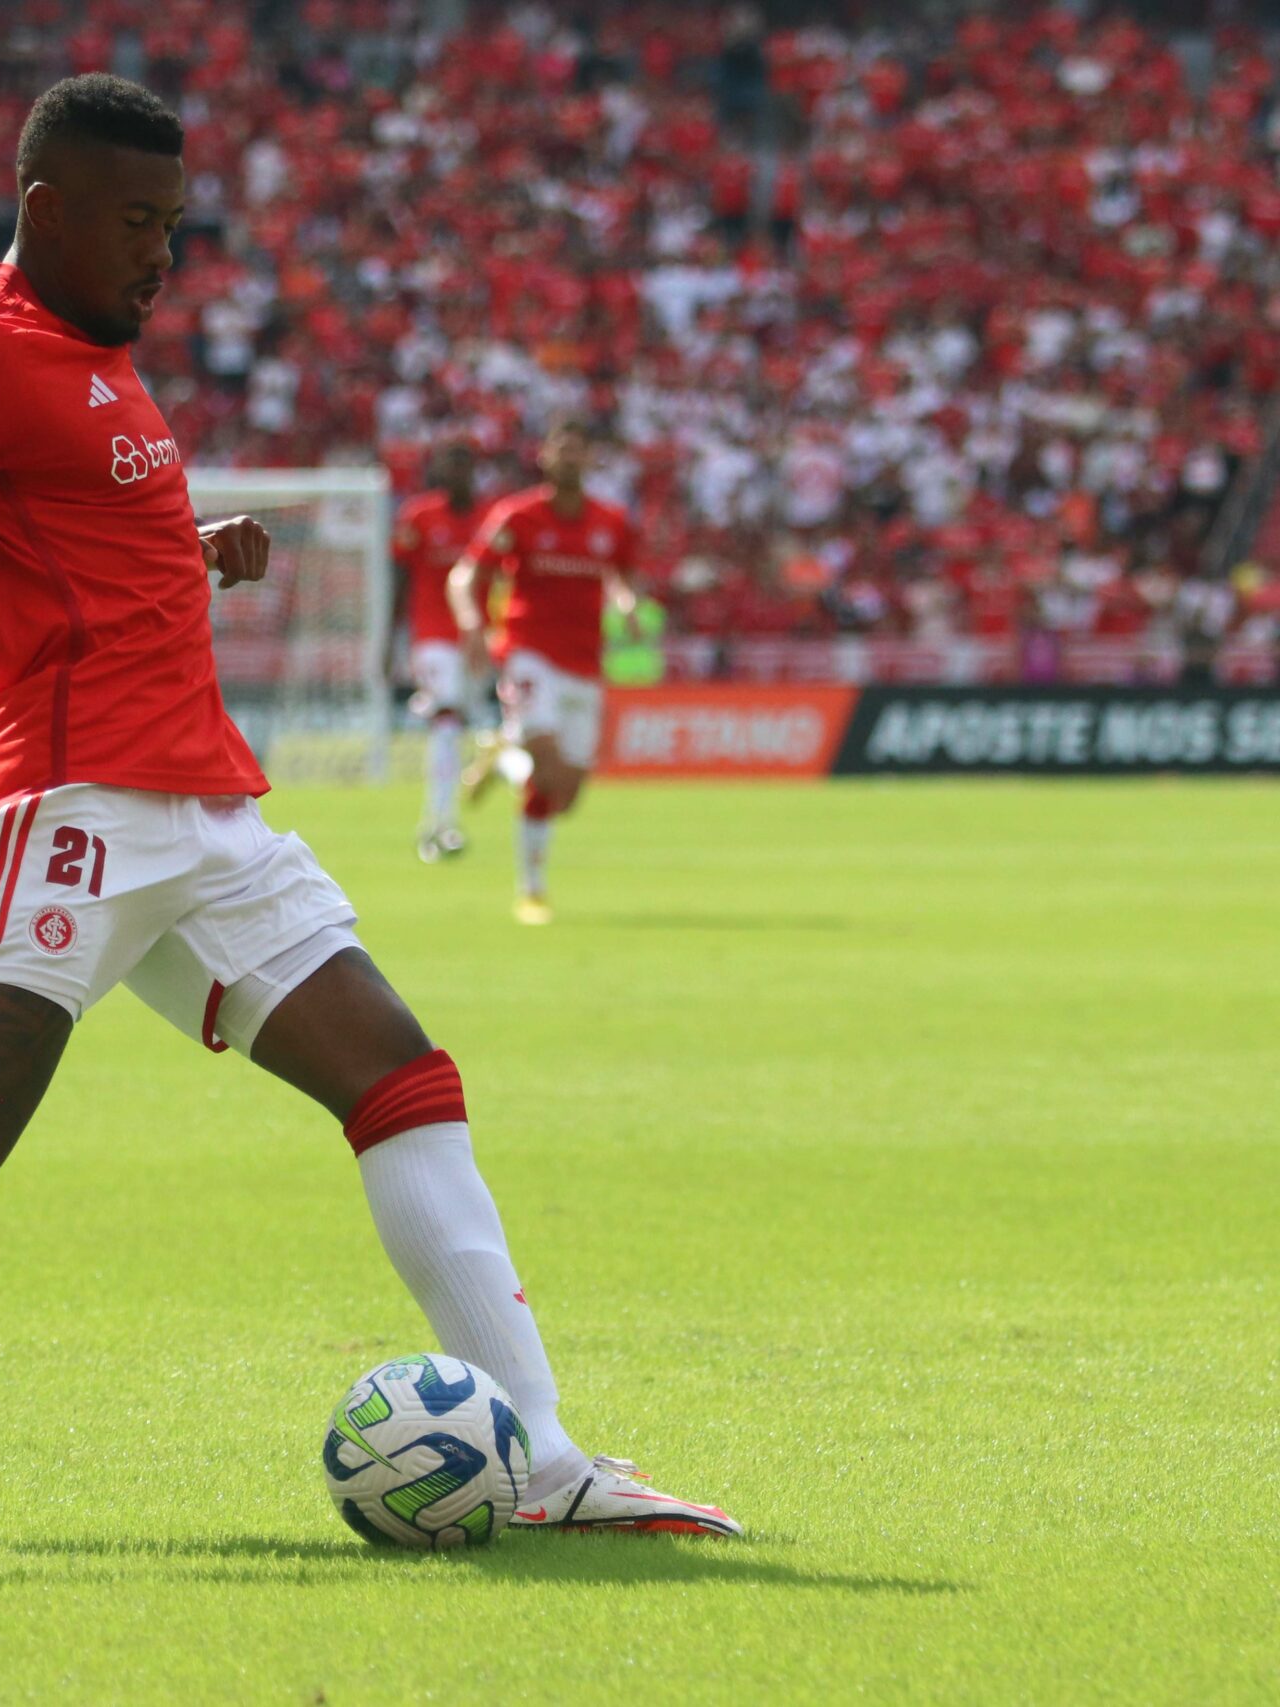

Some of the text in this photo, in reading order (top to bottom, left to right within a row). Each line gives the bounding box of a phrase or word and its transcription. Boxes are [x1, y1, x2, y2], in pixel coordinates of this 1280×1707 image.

[616, 705, 826, 764] BETANO
[867, 702, 1091, 764] APOSTE
[1097, 702, 1219, 764] NOS
[46, 826, 107, 897] 21
